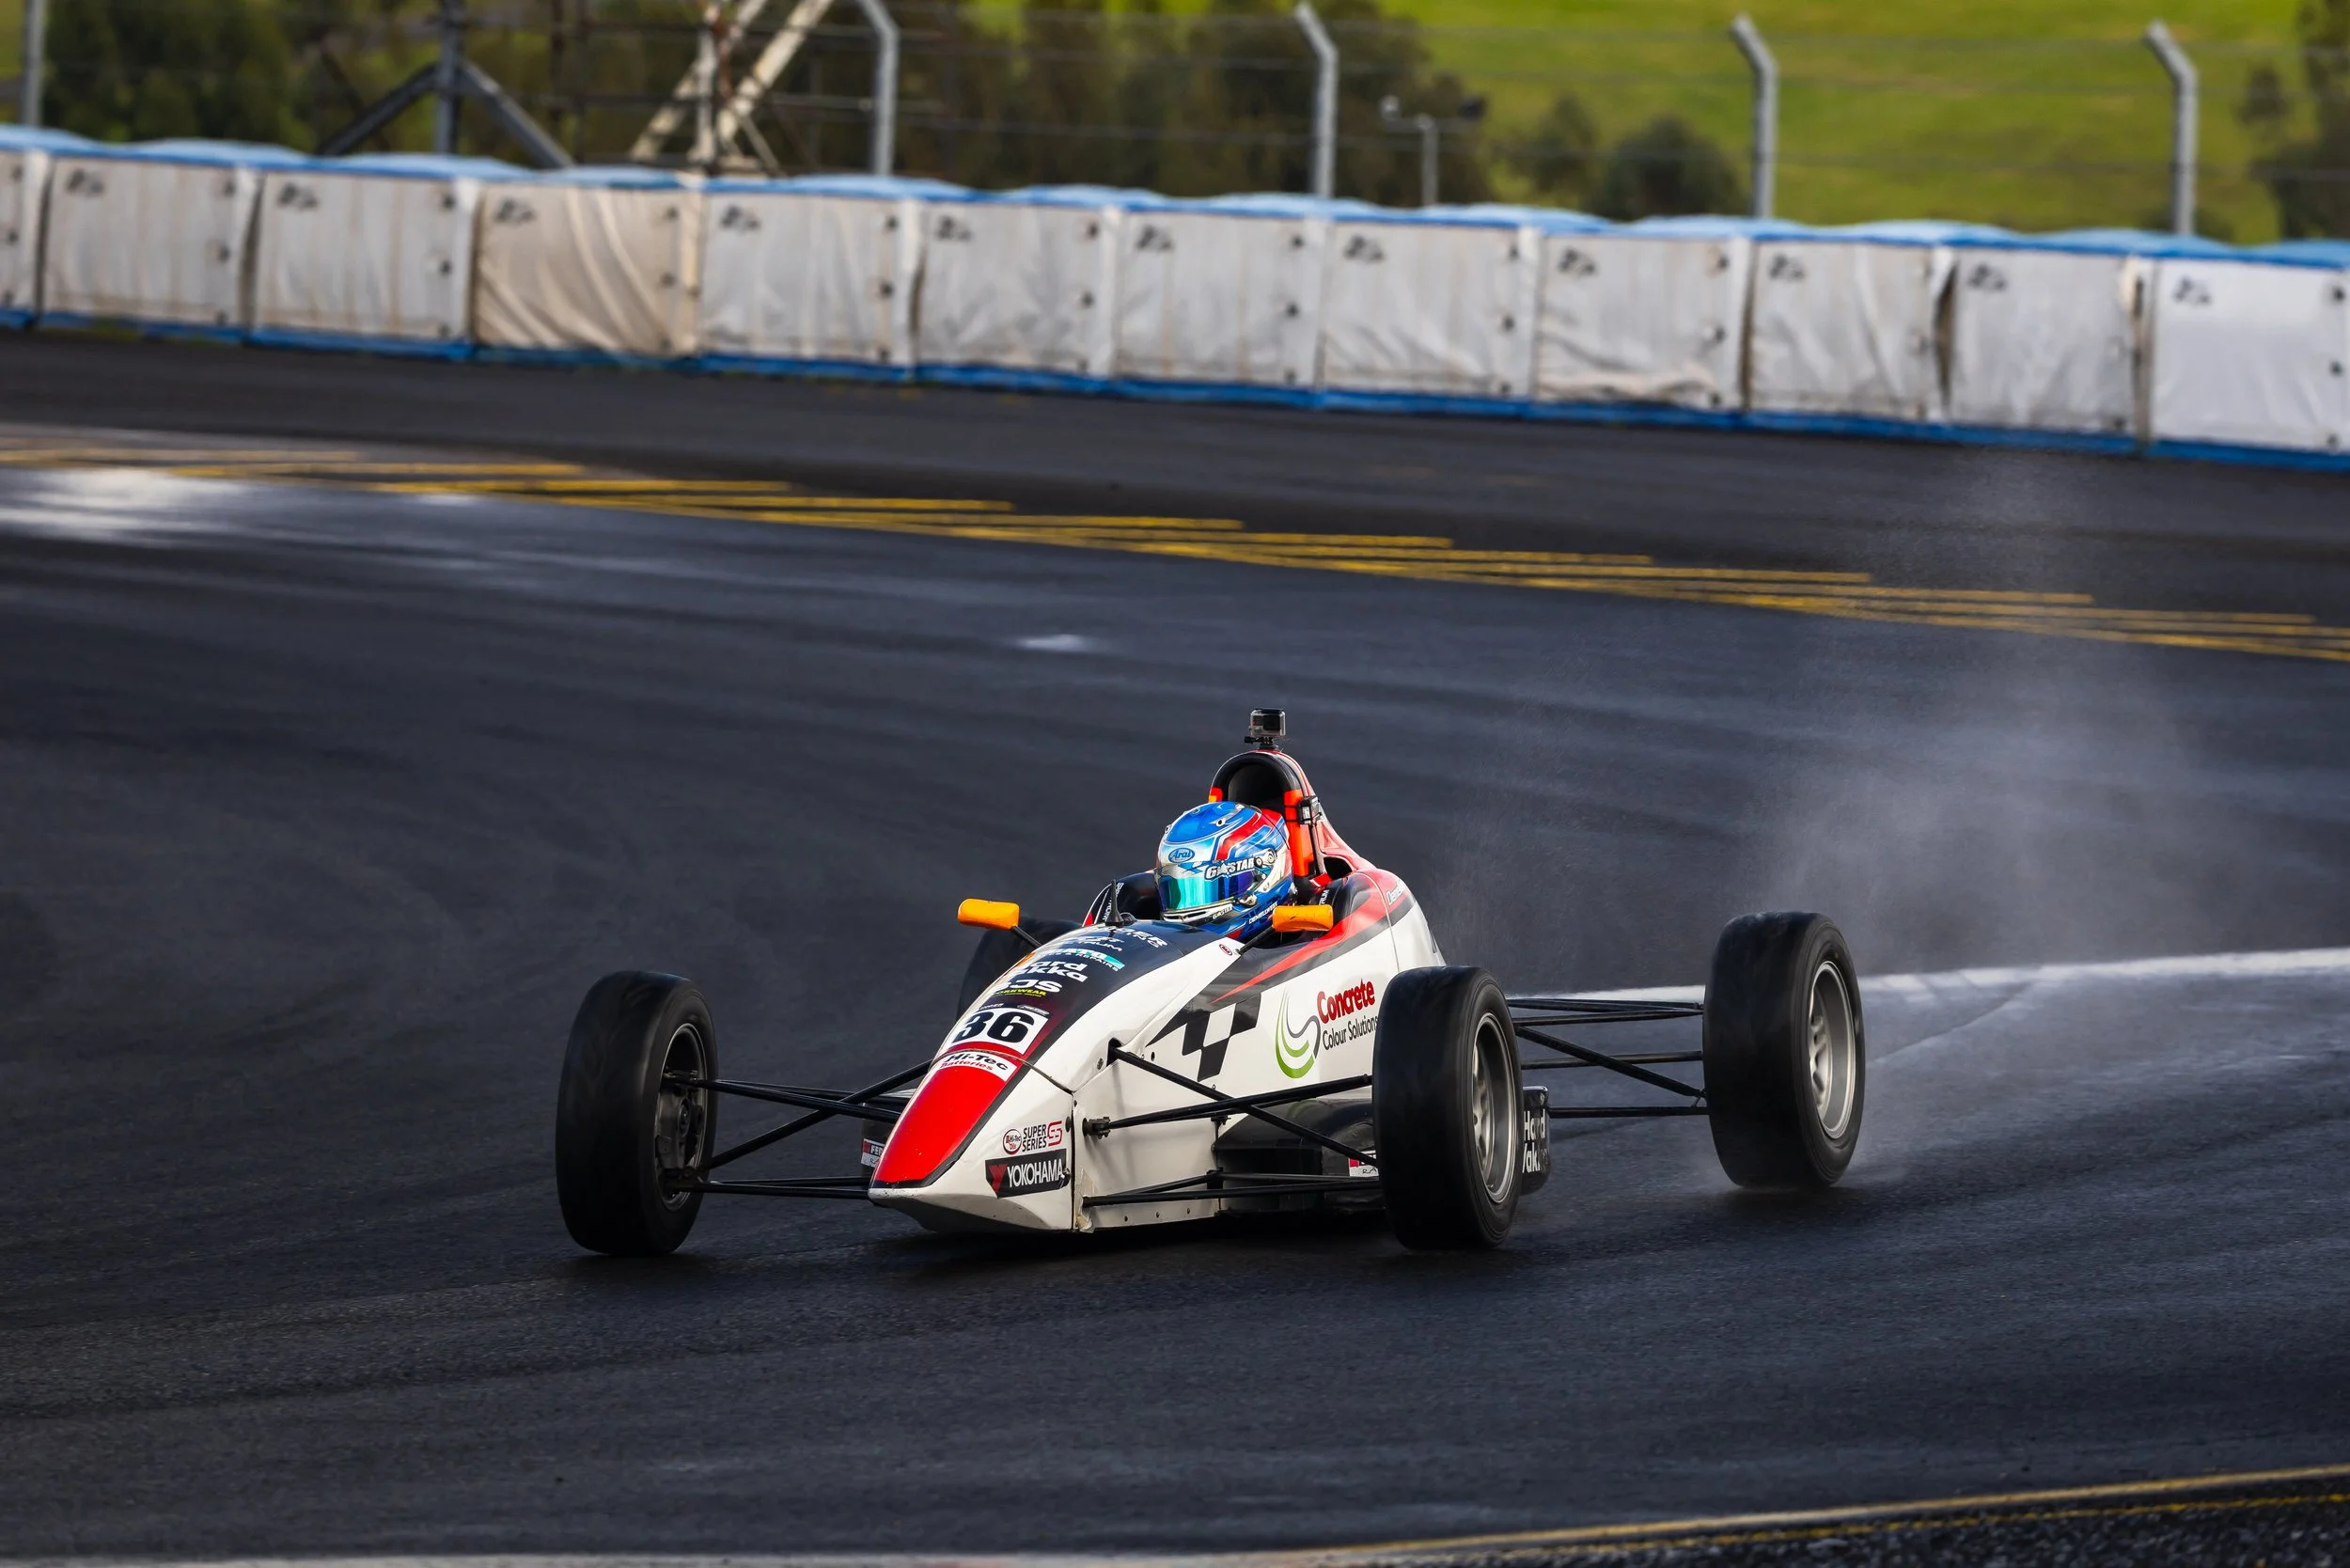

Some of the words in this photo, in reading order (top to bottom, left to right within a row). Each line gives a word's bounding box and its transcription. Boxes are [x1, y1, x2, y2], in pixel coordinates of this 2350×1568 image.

[1169, 849, 1191, 861] Arai
[1317, 978, 1375, 1024] Concrete
[951, 1011, 1035, 1043] 36
[1322, 1028, 1347, 1051] Colour
[940, 1059, 994, 1071] Batteries
[944, 1053, 1009, 1071] Hi-Tec
[1023, 1123, 1047, 1139] SUPER
[1022, 1136, 1047, 1152] SERIES
[1007, 1158, 1063, 1188] YOKOHAMA
